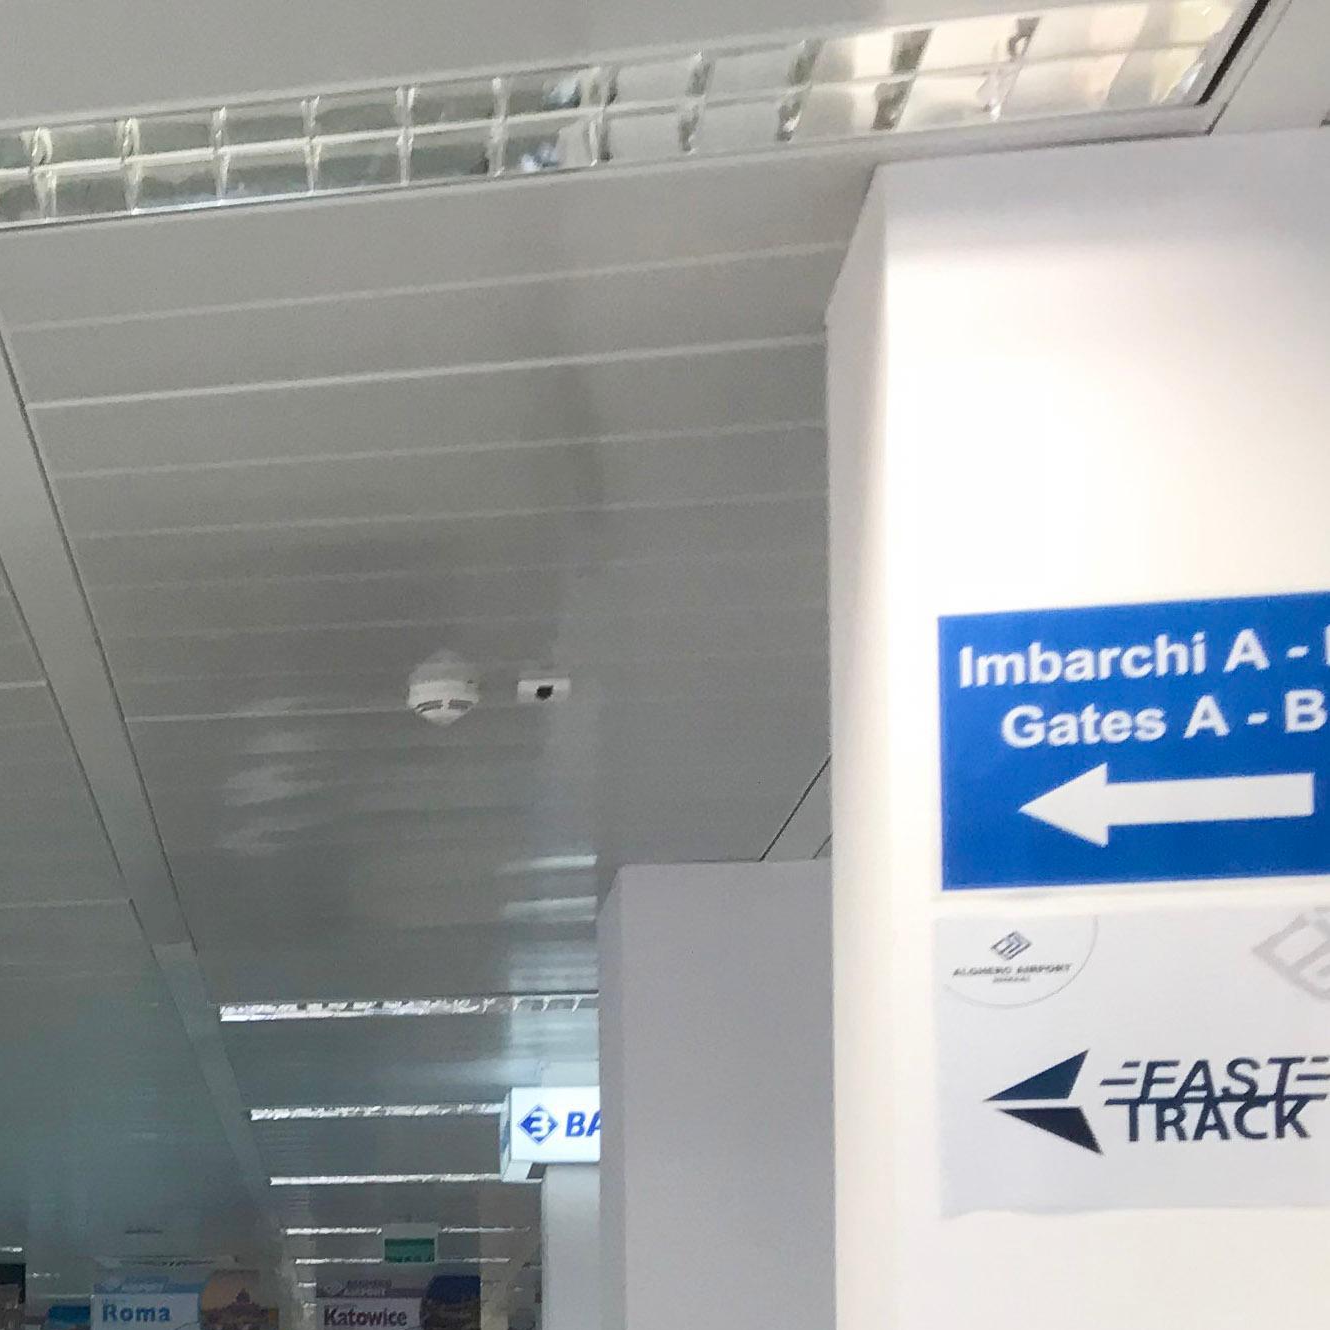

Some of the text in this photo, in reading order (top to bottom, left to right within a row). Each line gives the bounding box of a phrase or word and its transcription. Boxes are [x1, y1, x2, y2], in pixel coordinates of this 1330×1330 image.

[959, 631, 1208, 689] Imbarchi
[1223, 628, 1271, 673] A
[1001, 703, 1167, 749] Gates
[1183, 695, 1231, 738] A
[1284, 689, 1328, 733] B
[1116, 1096, 1312, 1142] TRACK
[102, 1302, 171, 1323] Roma
[323, 1306, 408, 1327] Katowice
